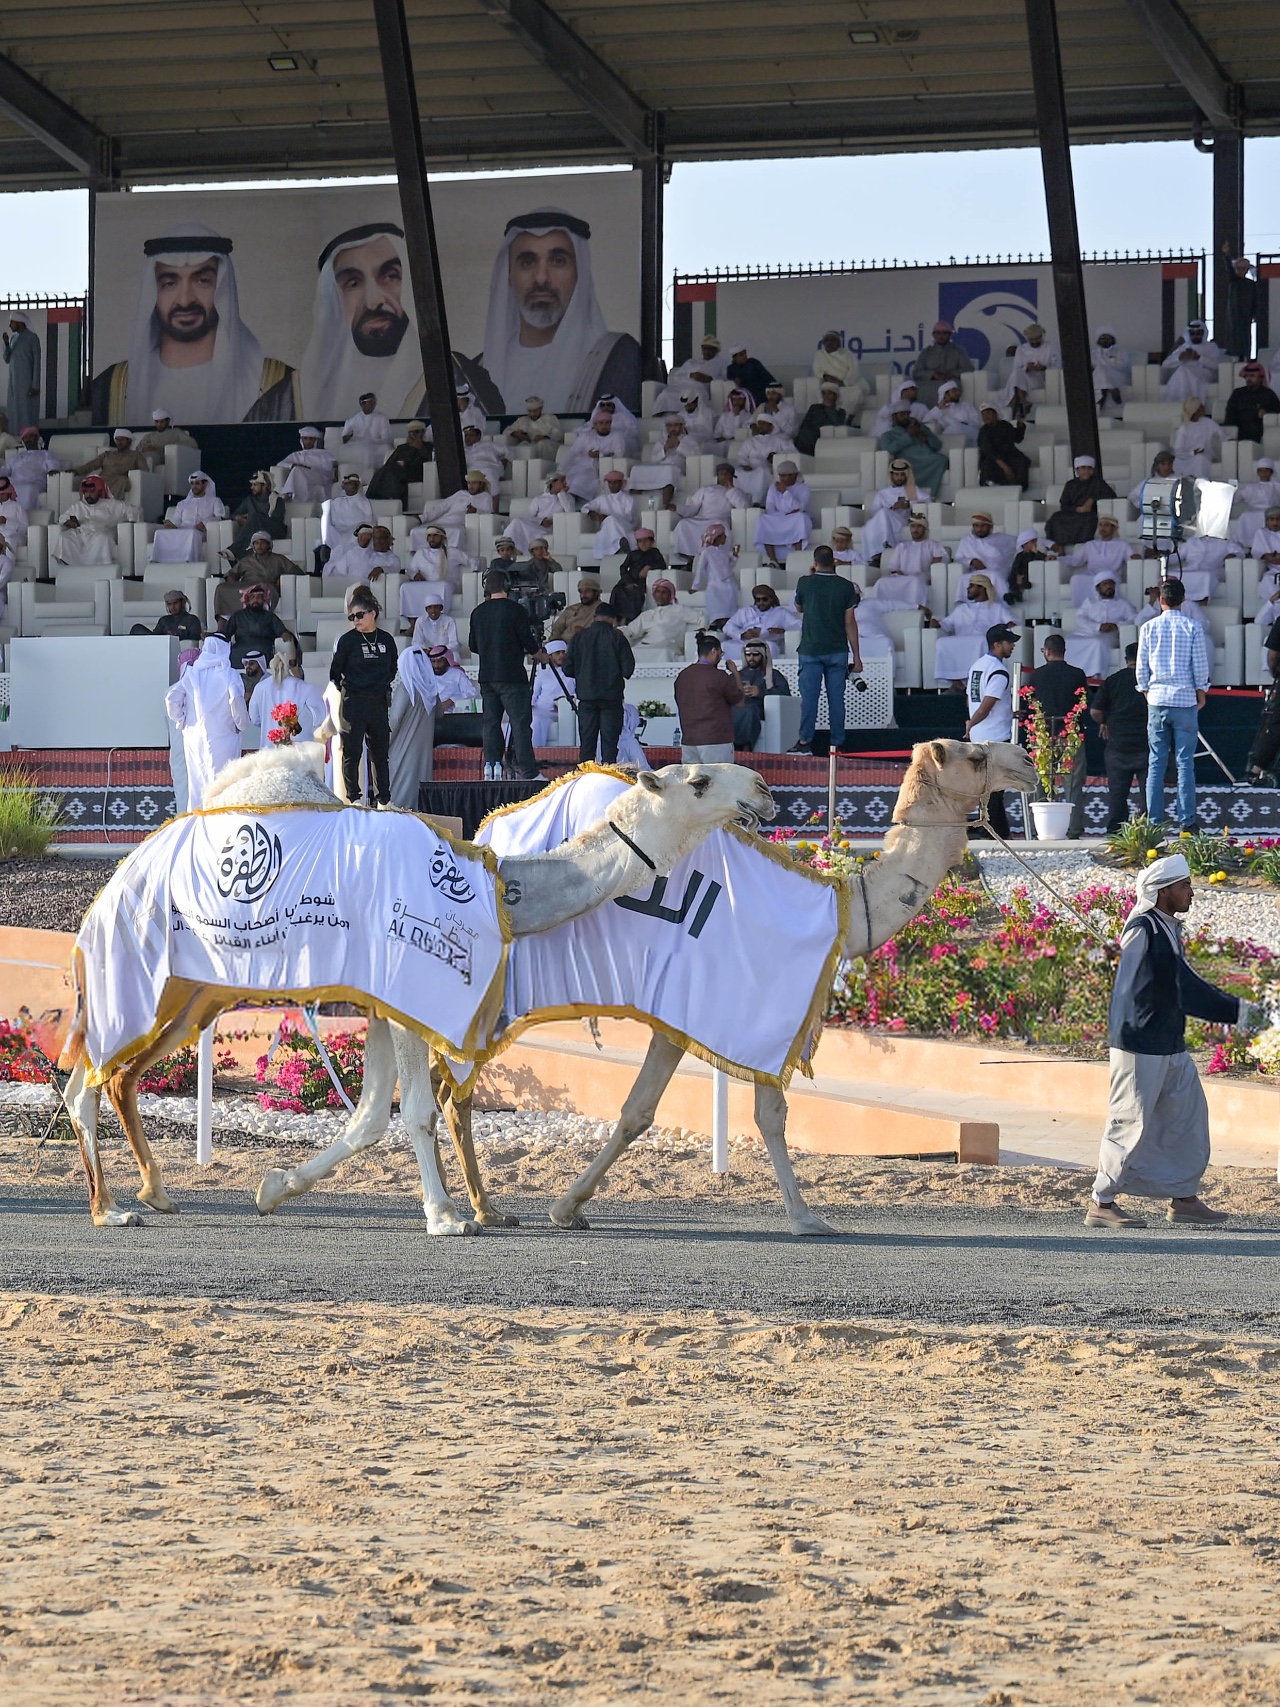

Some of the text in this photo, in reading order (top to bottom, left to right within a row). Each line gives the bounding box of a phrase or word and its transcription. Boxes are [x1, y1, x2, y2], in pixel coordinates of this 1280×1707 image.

[299, 892, 336, 907] شوط
[195, 914, 231, 929] السمو
[233, 908, 279, 933] أصحاب
[388, 919, 406, 939] AL
[255, 928, 280, 948] أبناء
